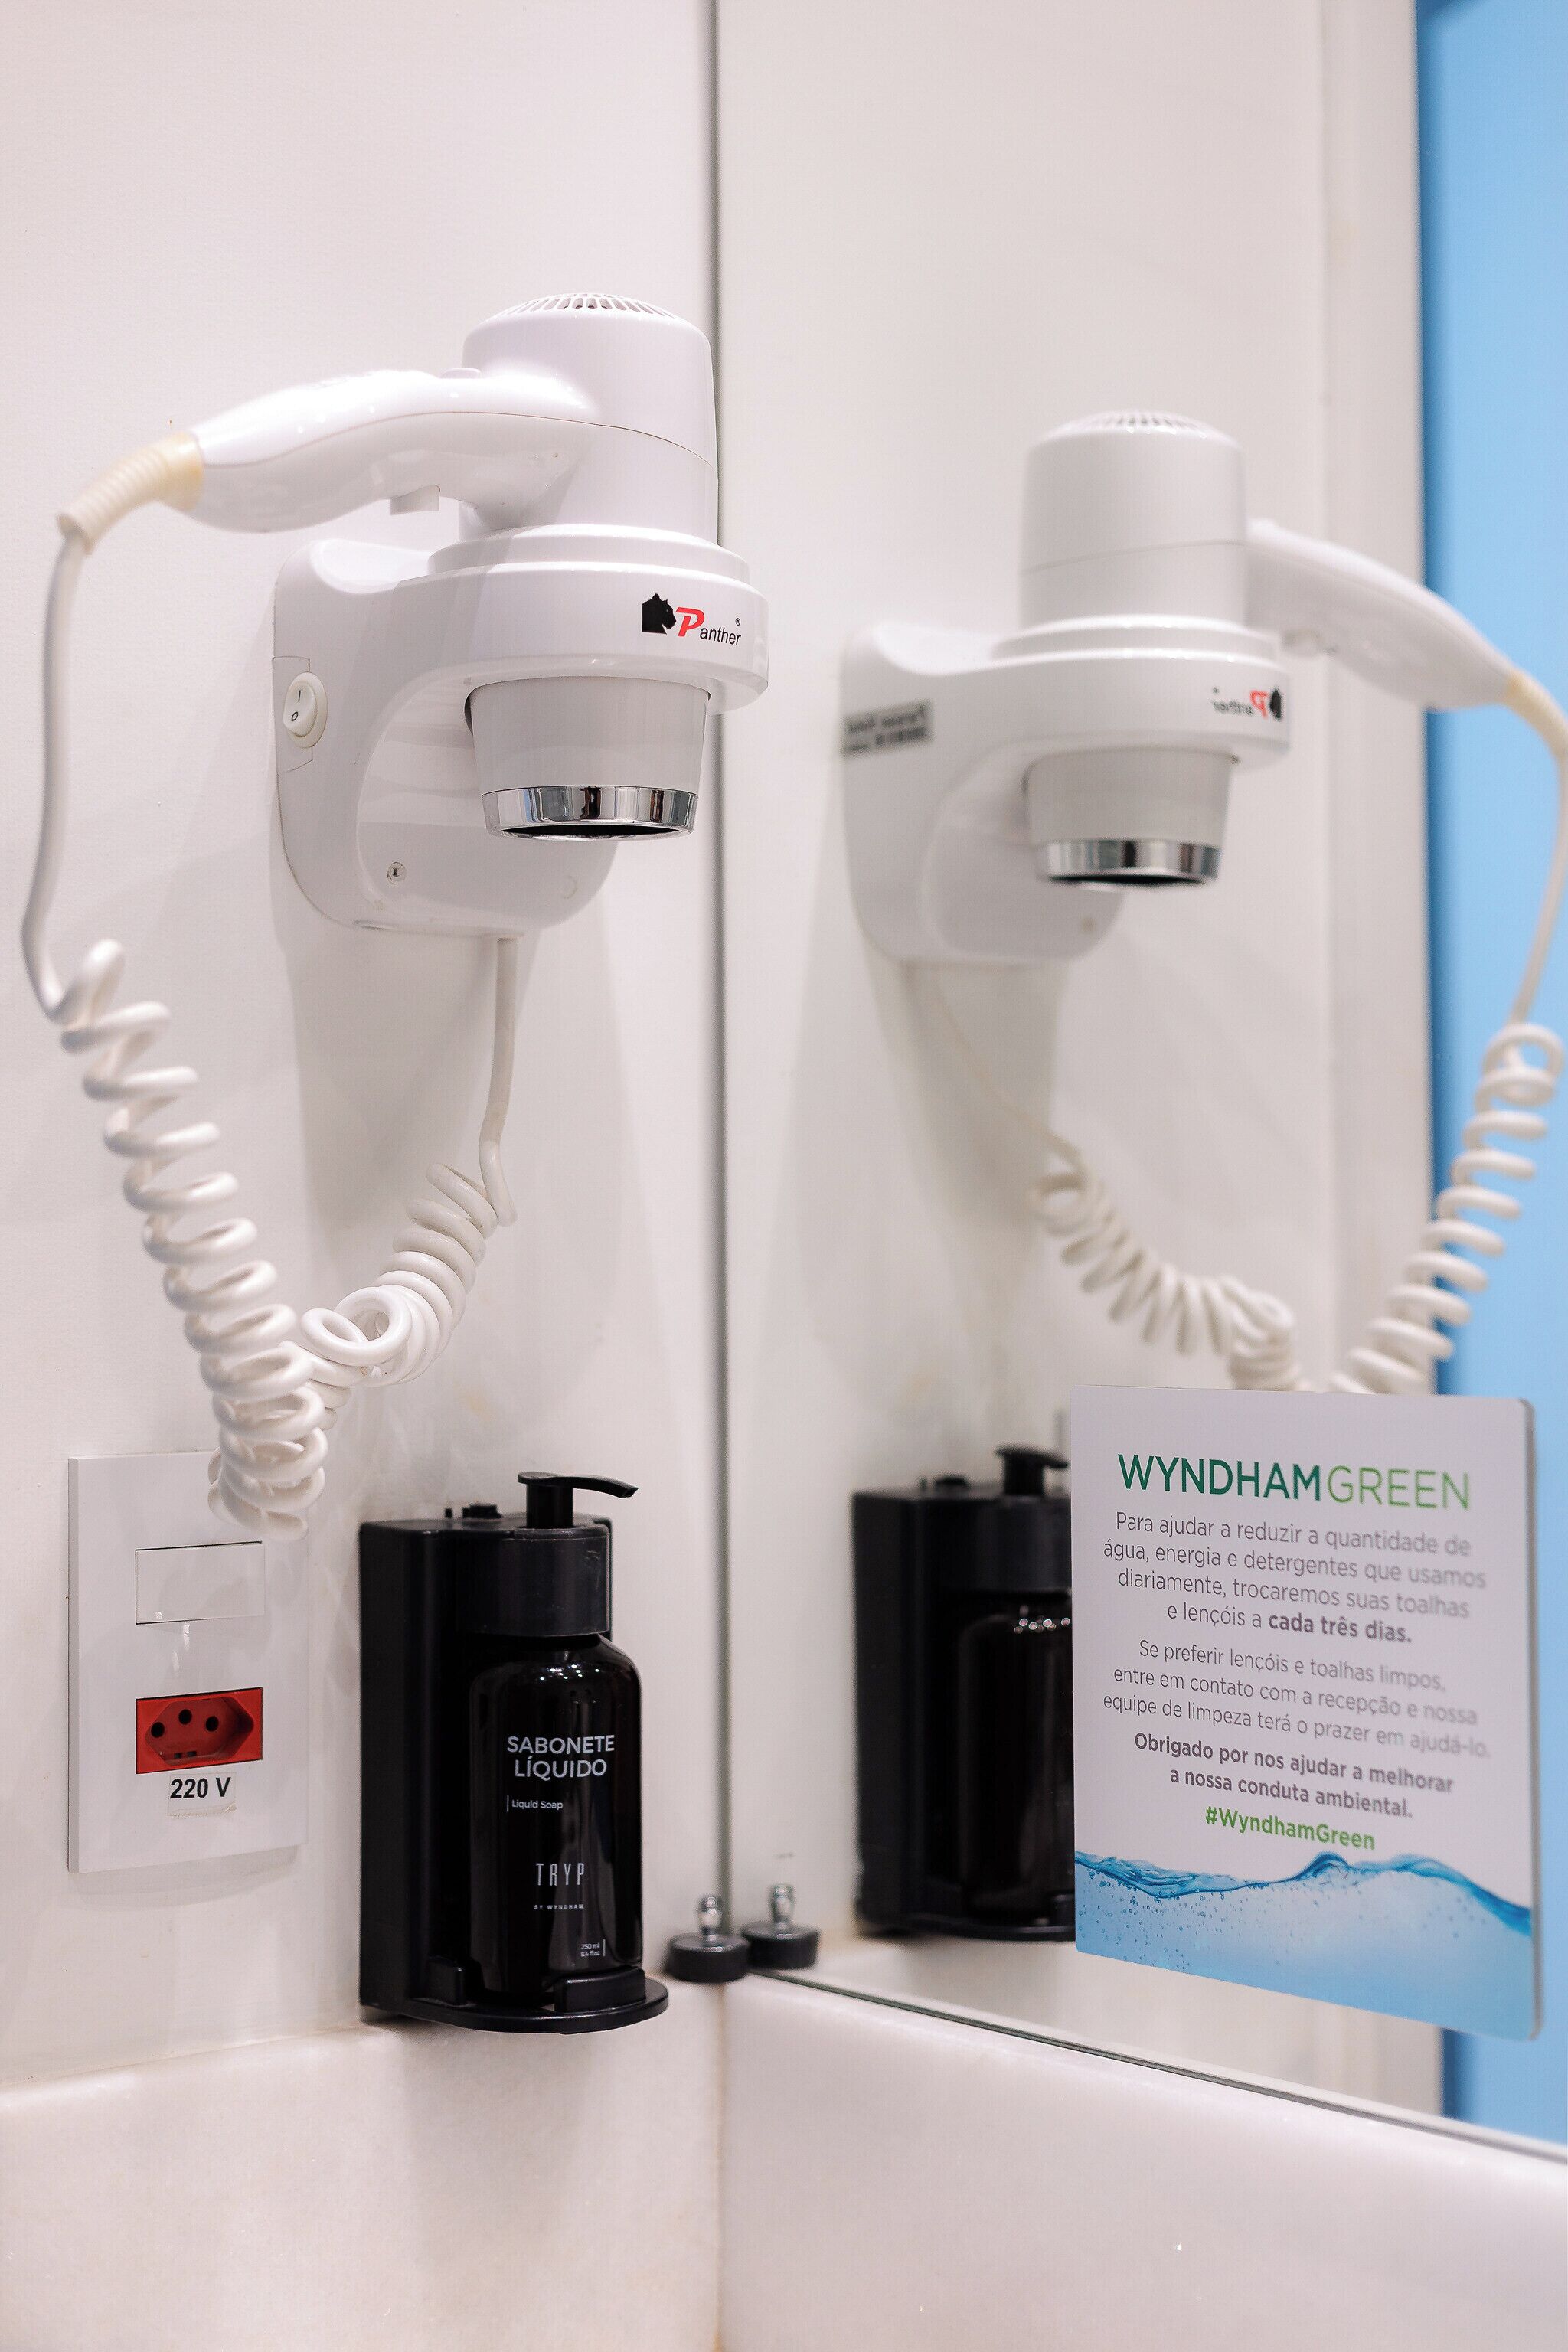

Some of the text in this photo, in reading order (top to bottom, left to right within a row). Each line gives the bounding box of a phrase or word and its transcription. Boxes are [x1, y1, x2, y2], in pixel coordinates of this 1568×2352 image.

[1116, 1511, 1471, 1556] Para ajudar a reduzir a quantidade de
[1103, 1538, 1486, 1589] água, energia e detergentes que usamos
[1119, 1568, 1469, 1619] diariamente, trocaremos suas toalhas
[1168, 1602, 1412, 1643] e lençóis a cada três dias.
[1139, 1639, 1158, 1658] Se
[1164, 1645, 1224, 1665] preferir
[1230, 1648, 1289, 1672] lençóis
[1295, 1660, 1304, 1674] e
[1311, 1658, 1374, 1683] toalhas
[1114, 1668, 1478, 1726] entre em contato com a recepção e nossa
[507, 1735, 615, 1754] SABONETE
[1103, 1695, 1490, 1758] equipe de limpeza terá o prazer em ajudá-lo.
[514, 1755, 607, 1781] LÍQUIDO
[1135, 1732, 1453, 1792] Obrigado por nos ajudar a melhorar
[170, 1777, 231, 1799] 220 V
[511, 1799, 564, 1811] Liquid Soap
[1170, 1769, 1413, 1818] a nossa conduta ambiental.
[1205, 1806, 1374, 1850] #WyndhamGreen
[535, 1862, 585, 1886] TRYP
